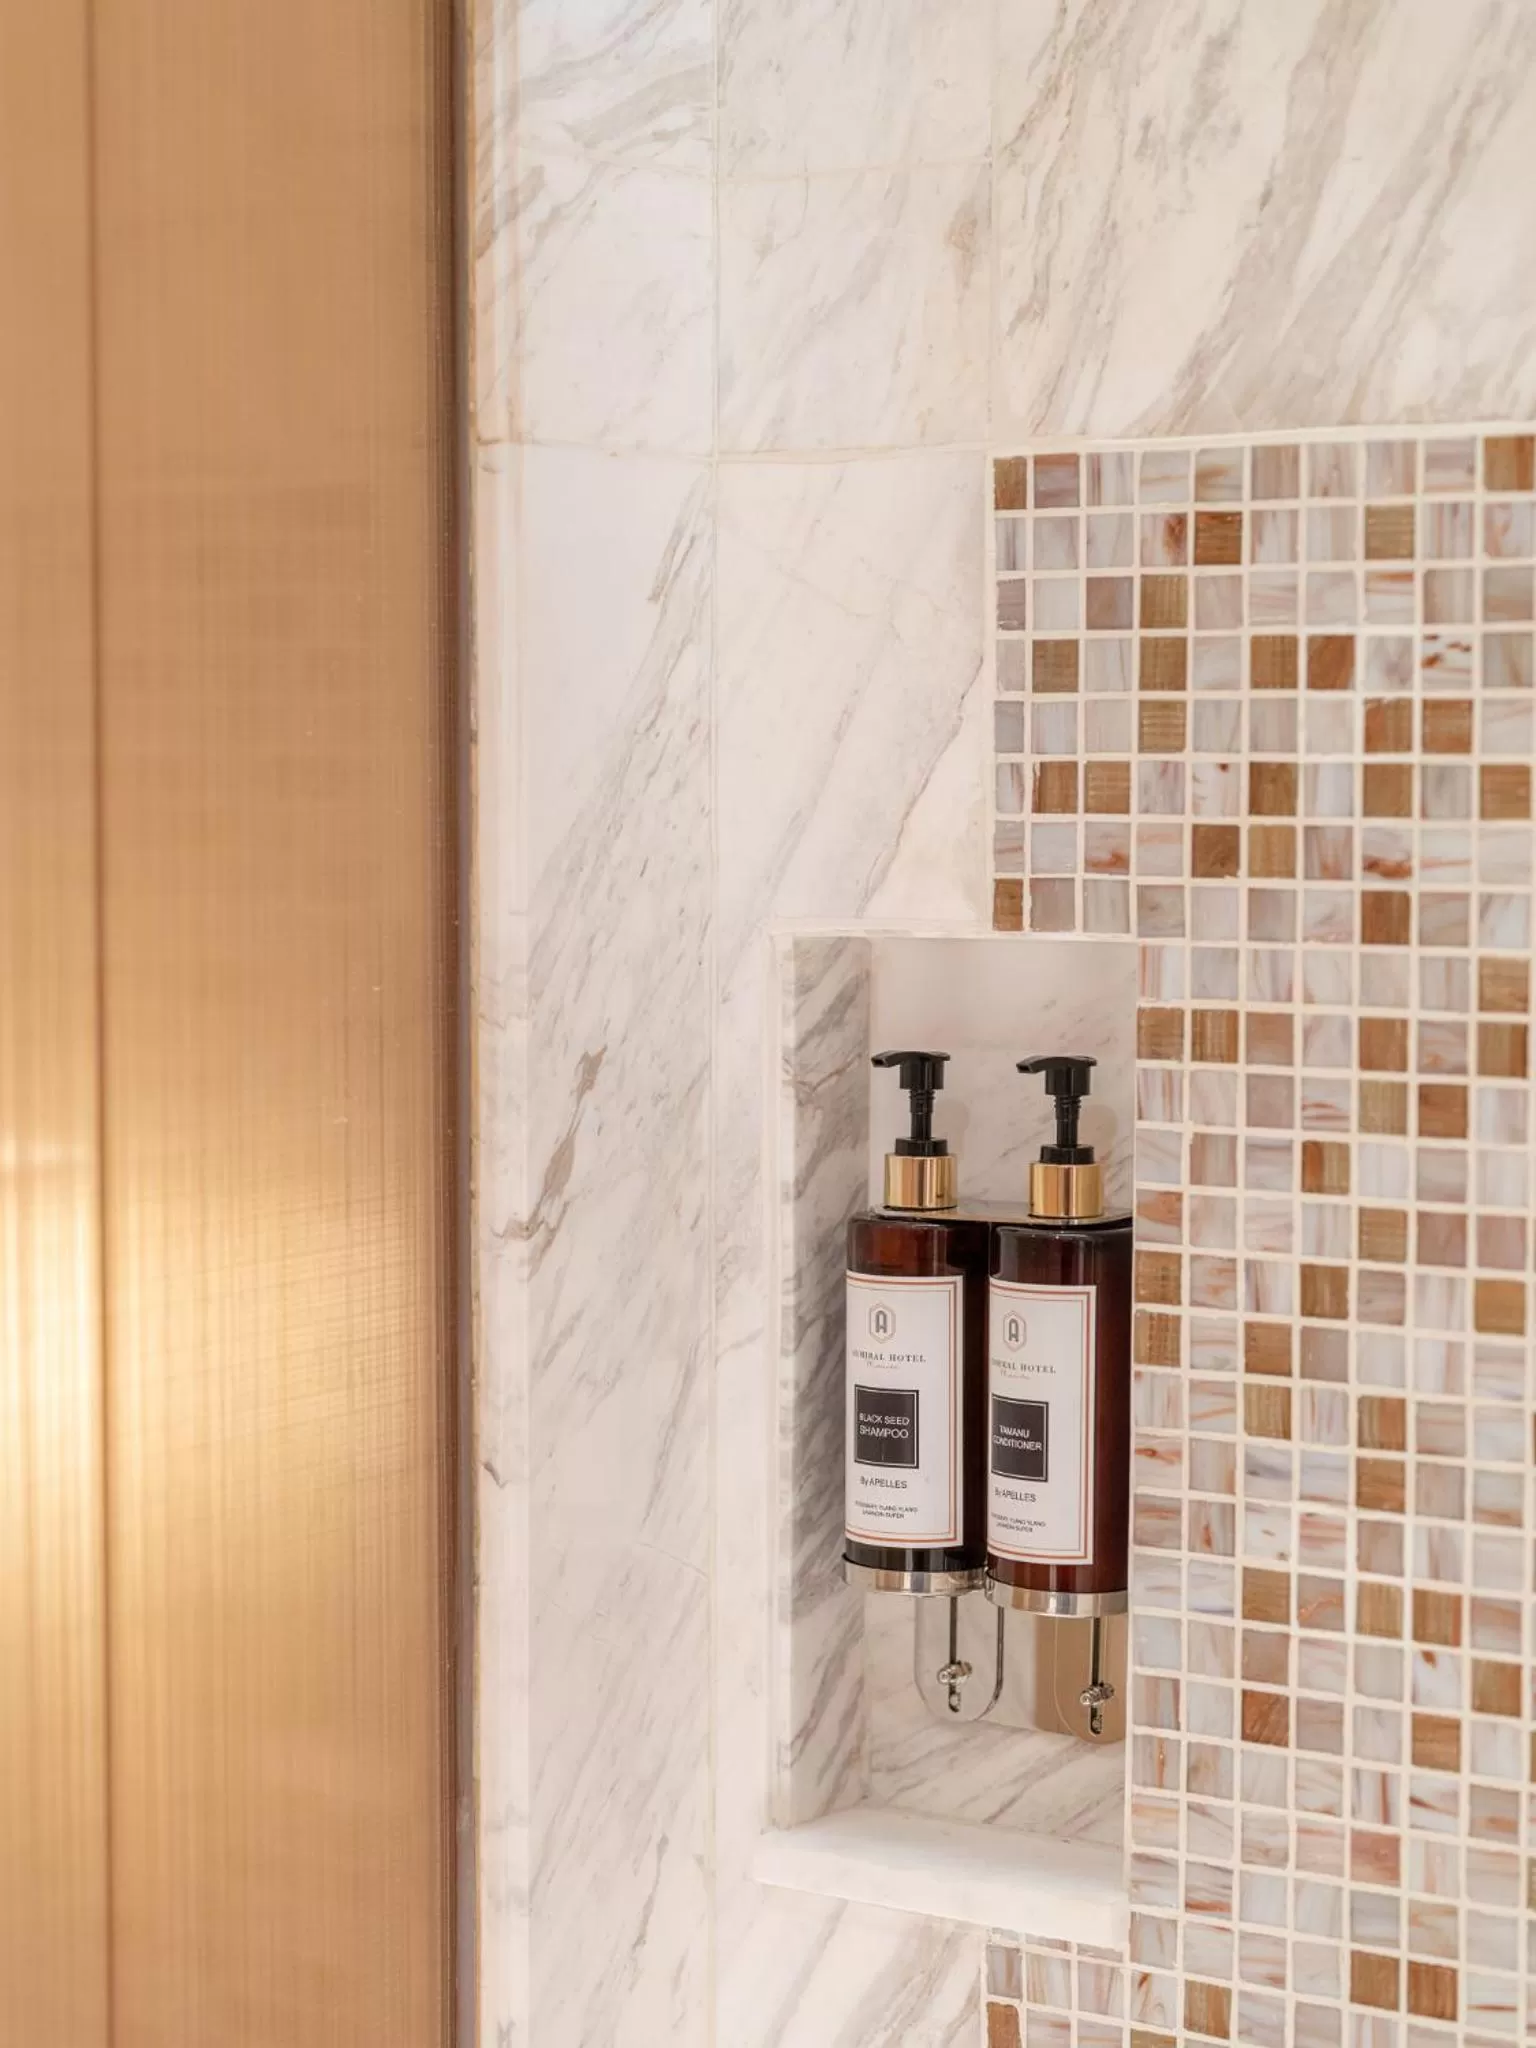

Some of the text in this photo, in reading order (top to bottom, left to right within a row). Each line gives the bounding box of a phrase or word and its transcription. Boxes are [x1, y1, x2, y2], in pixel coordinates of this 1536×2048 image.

[889, 1353, 927, 1363] HOTEL
[1020, 1362, 1057, 1374] HOTEL
[859, 1412, 910, 1426] BLACK SEED
[859, 1424, 909, 1439] SHAMPOO
[860, 1475, 908, 1489] By APELLES
[1002, 1489, 1037, 1502] APELLES
